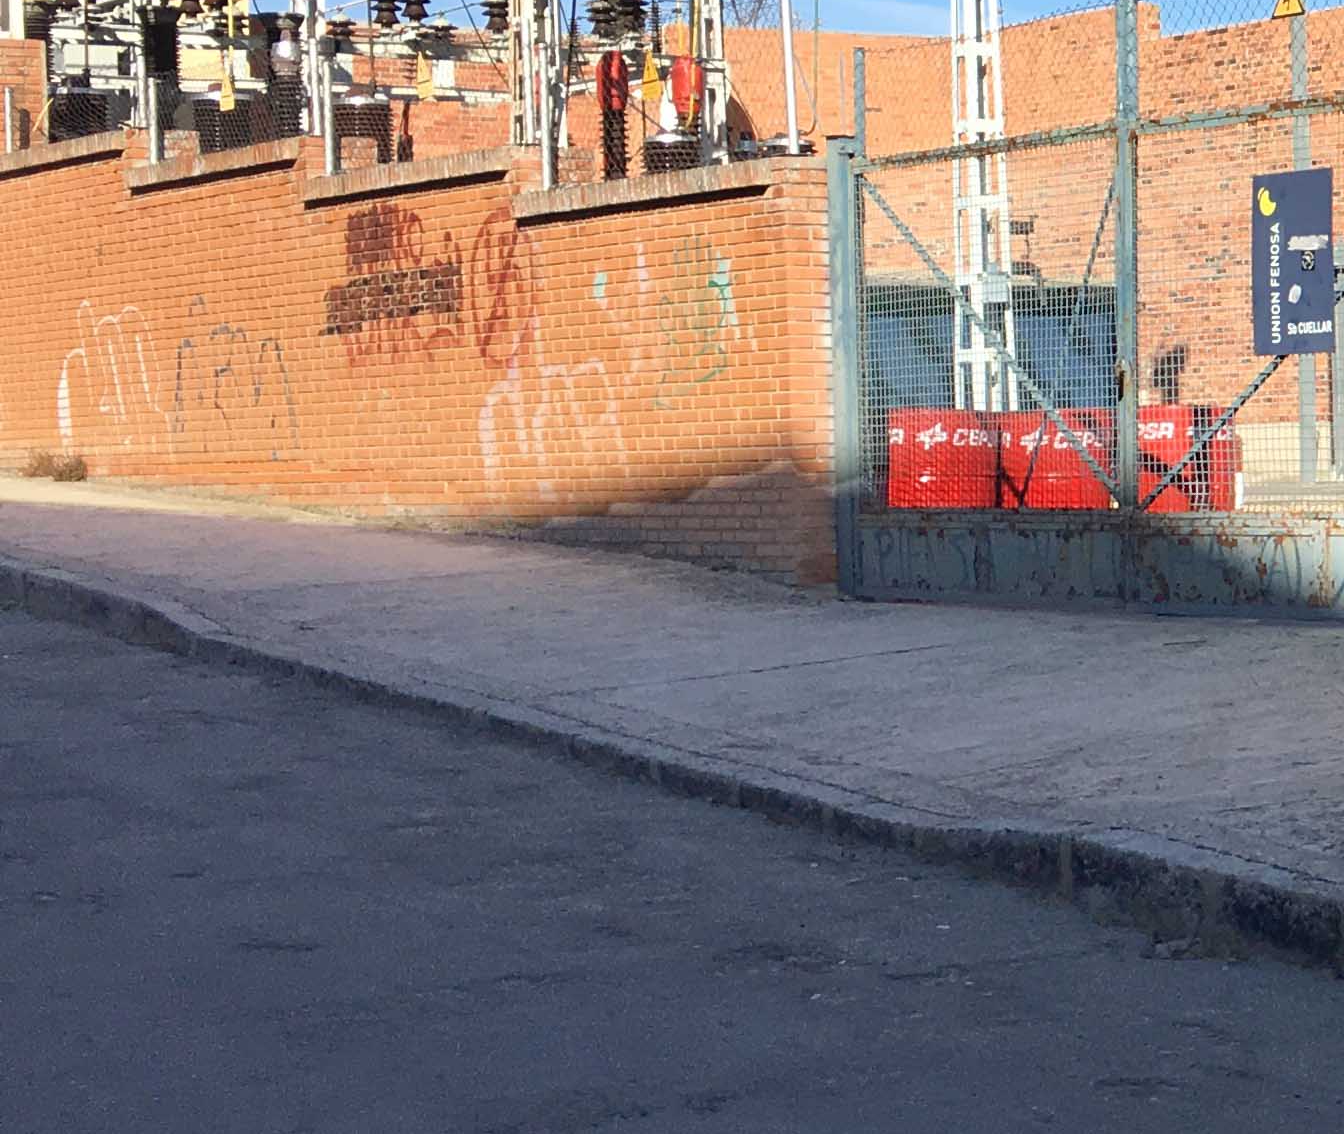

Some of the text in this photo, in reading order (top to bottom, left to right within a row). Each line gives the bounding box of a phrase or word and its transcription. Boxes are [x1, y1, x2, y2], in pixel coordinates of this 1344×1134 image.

[1270, 222, 1281, 344] UNION FENOSA
[1298, 320, 1332, 334] CUELLAR
[952, 428, 1012, 448] CEPA
